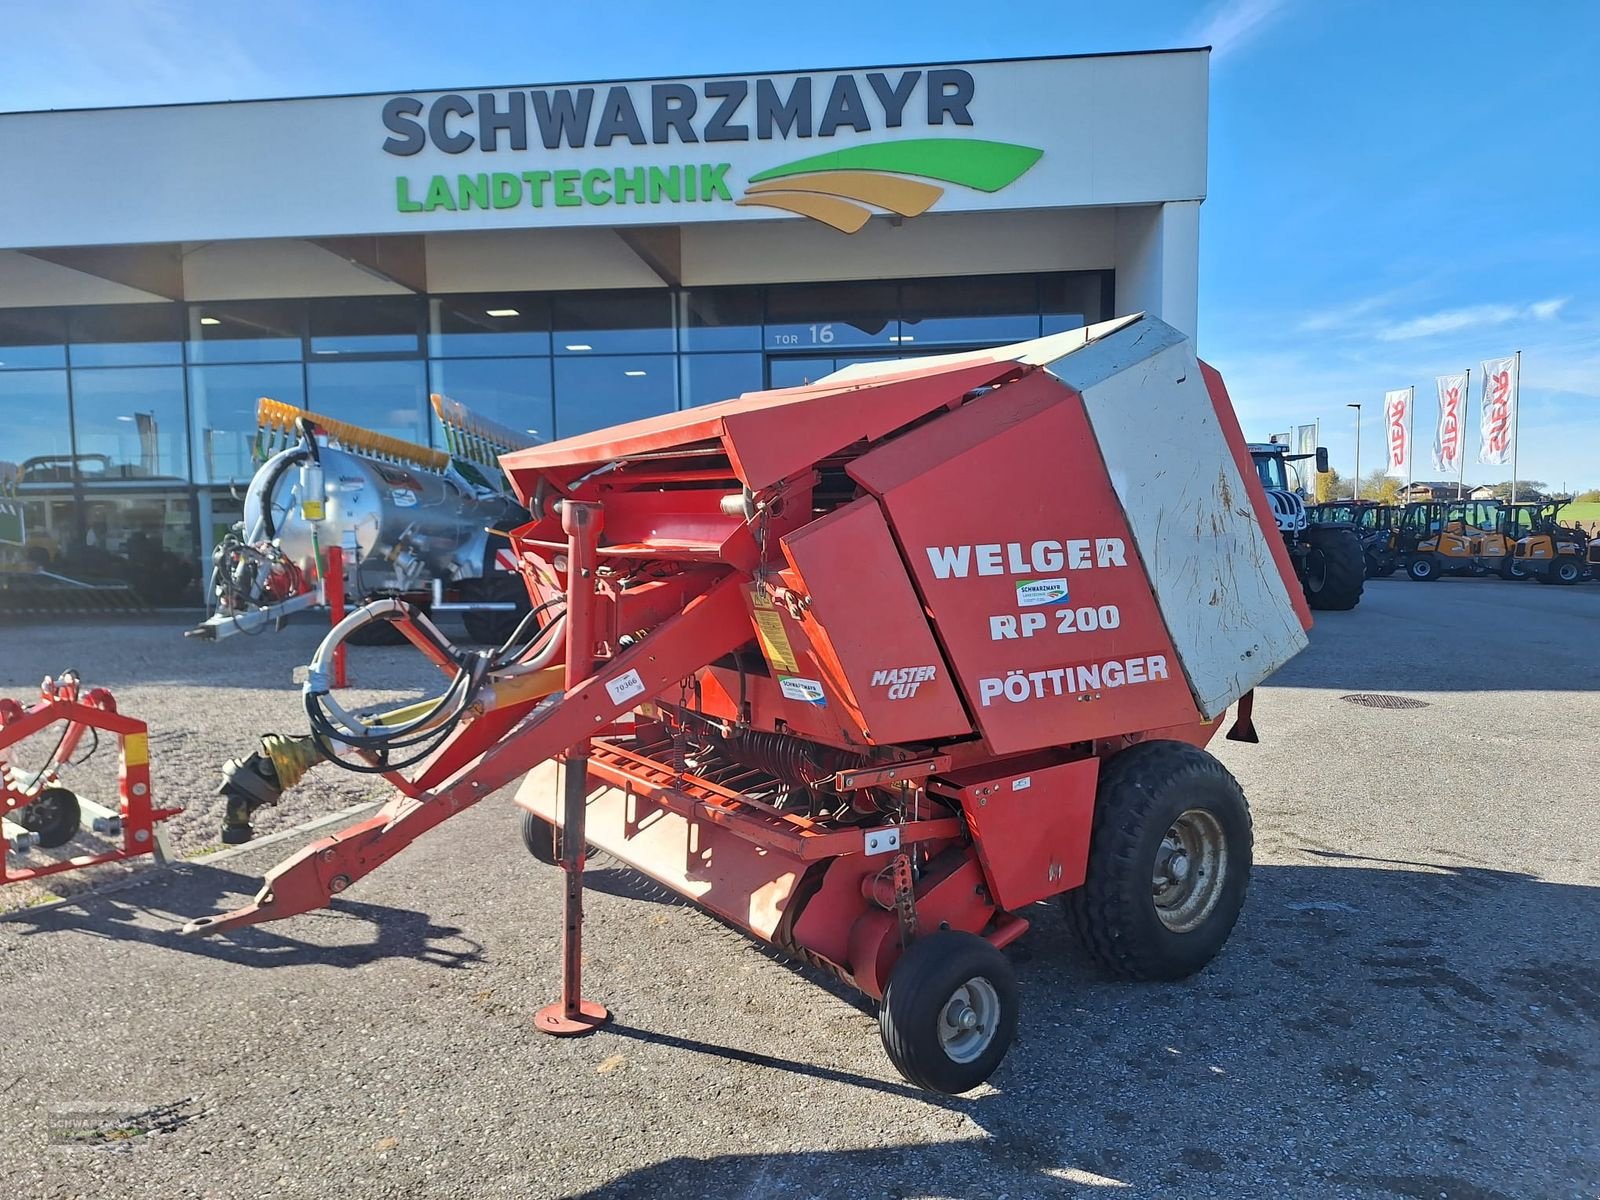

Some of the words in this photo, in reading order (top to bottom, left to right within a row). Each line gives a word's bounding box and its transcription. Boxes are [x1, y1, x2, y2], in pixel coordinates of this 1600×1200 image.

[382, 68, 974, 156] SCHWARZMAYR
[396, 162, 733, 213] LANDTECHNIK
[775, 335, 798, 344] TOR
[809, 324, 834, 343] 16
[926, 538, 1128, 579] WELGER
[989, 612, 1046, 640] RP
[1055, 605, 1120, 634] 200
[871, 665, 936, 687] MASTER
[888, 682, 920, 700] CUT
[979, 654, 1168, 706] PÖTTINGER
